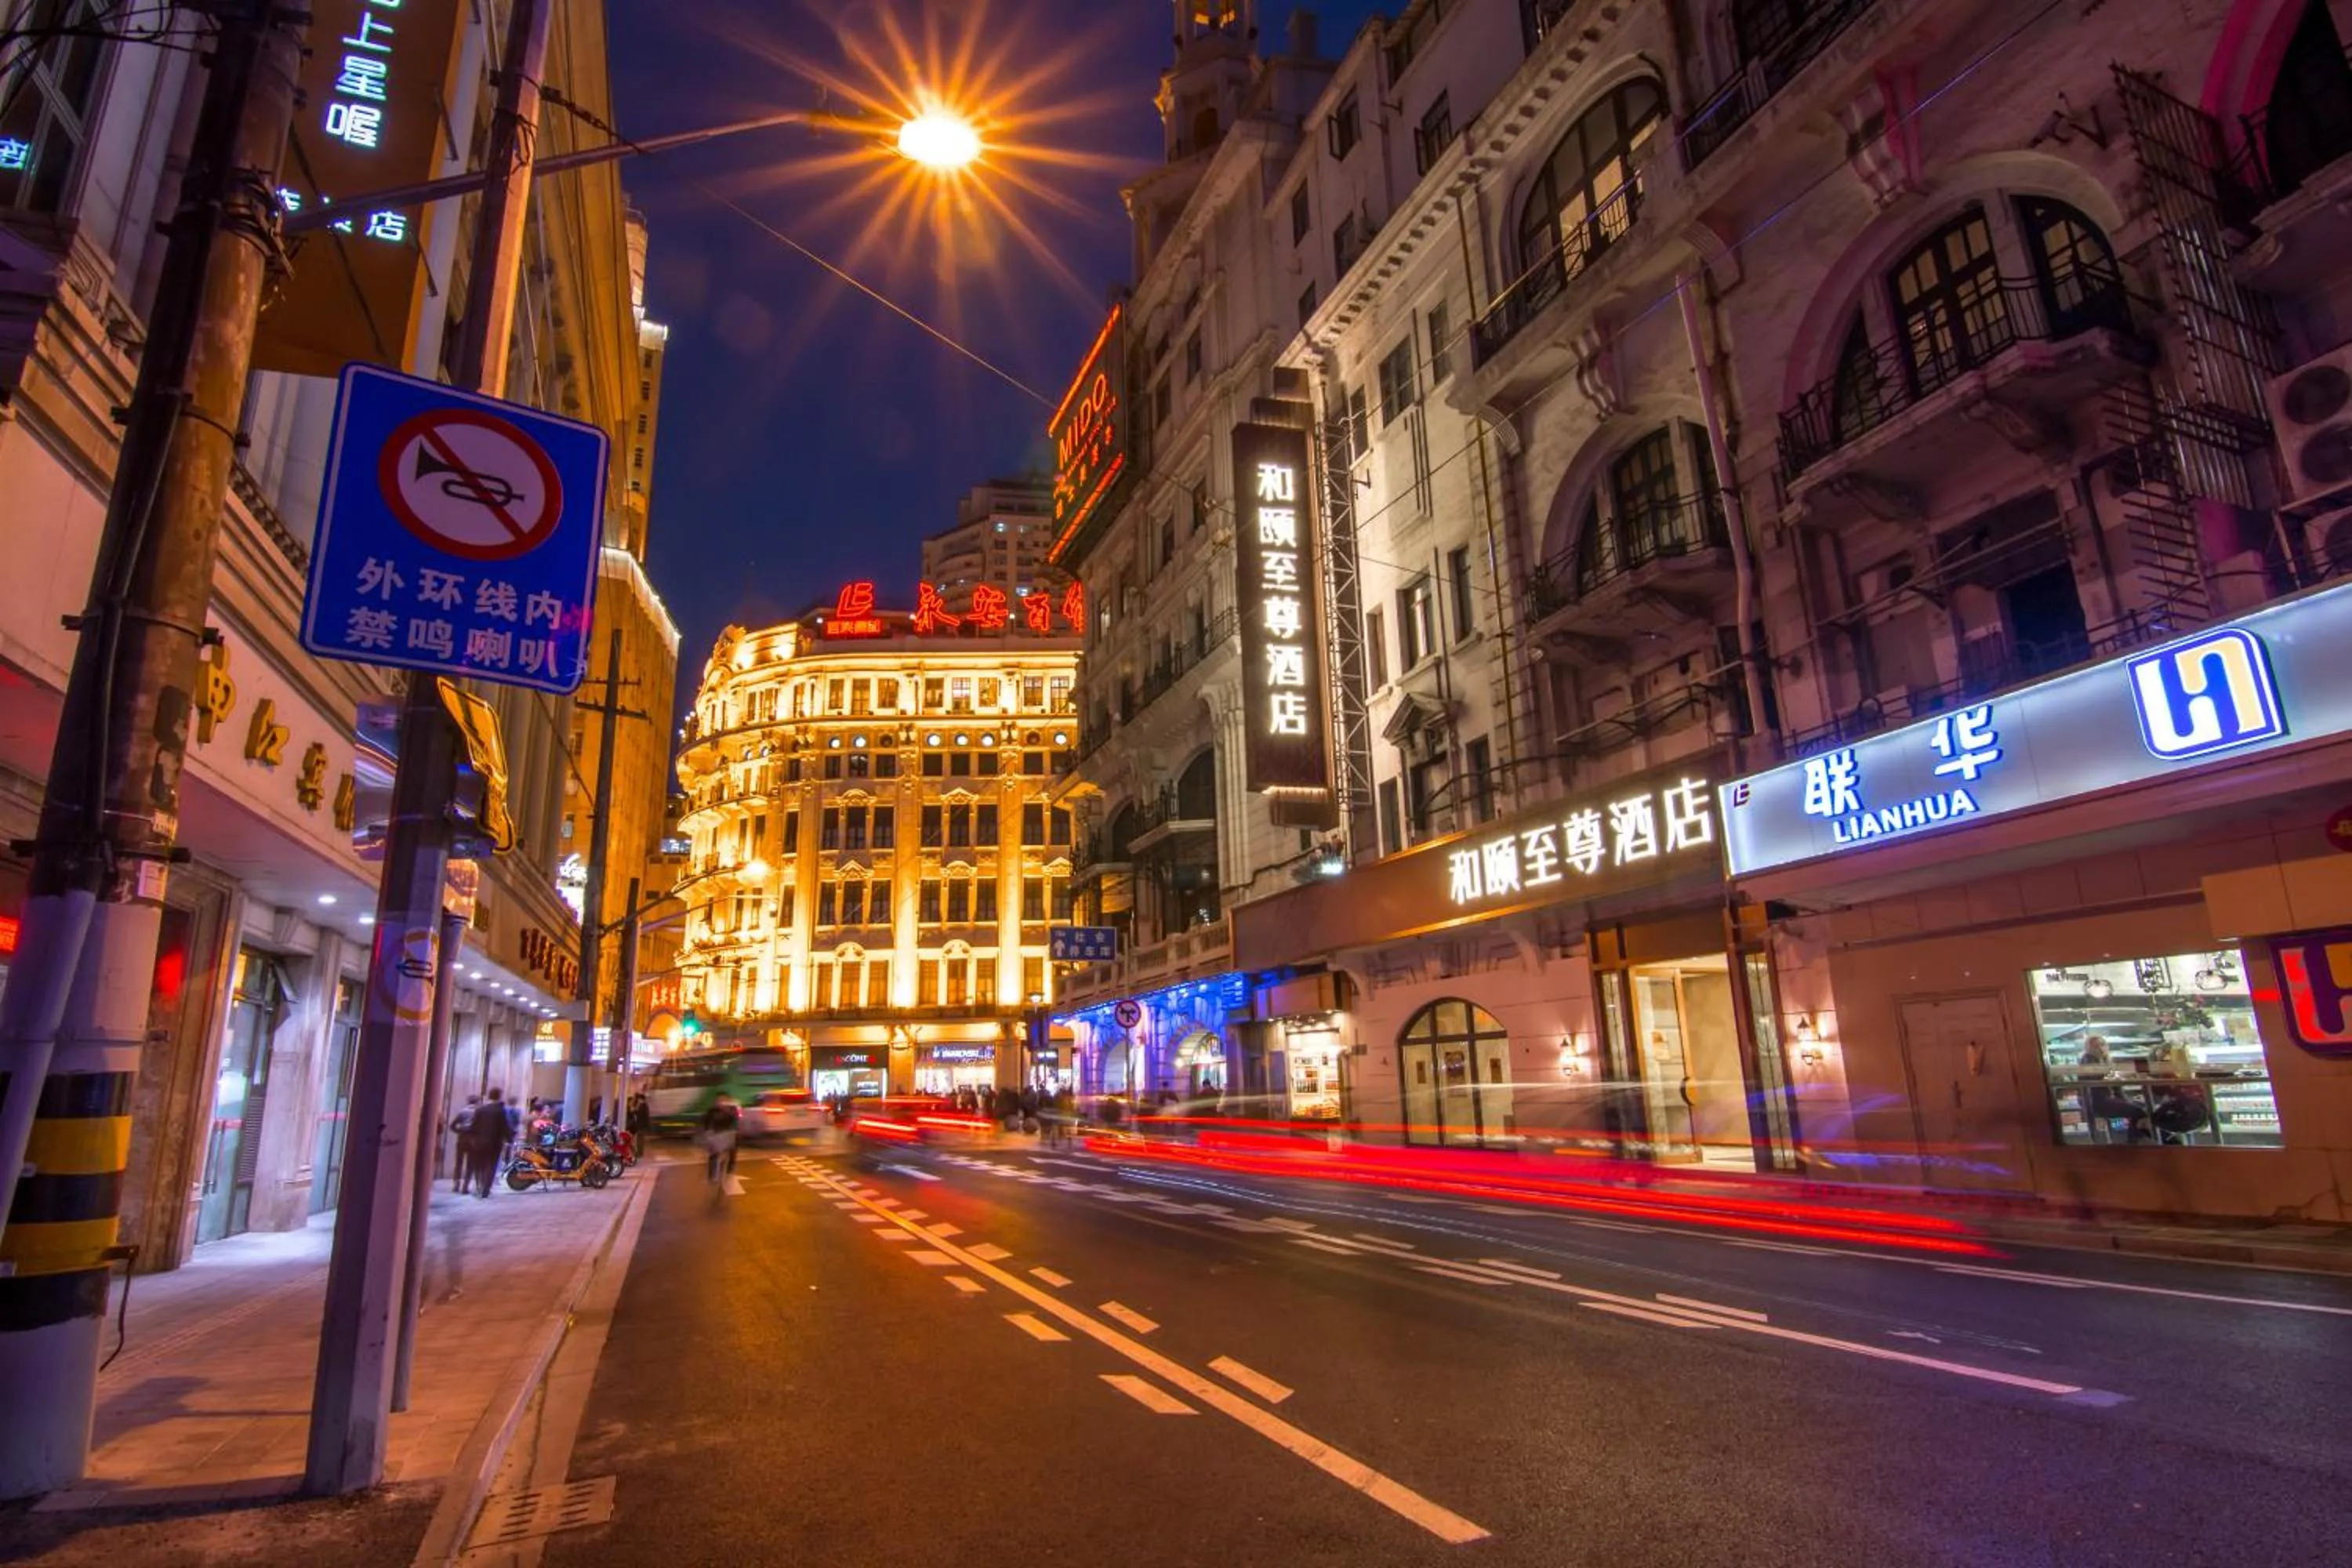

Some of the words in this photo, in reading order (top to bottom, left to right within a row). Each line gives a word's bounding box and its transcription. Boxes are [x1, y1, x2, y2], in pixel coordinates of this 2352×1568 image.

[1059, 374, 1106, 470] MIDO
[356, 557, 563, 630] 外环线内
[1257, 463, 1306, 735] 和颐至尊酒店
[345, 606, 559, 678] 禁鸣喇叭
[1805, 706, 2002, 816] 联华
[1449, 778, 1712, 905] 和颐至尊酒店
[1833, 789, 1979, 844] LIANHUA
